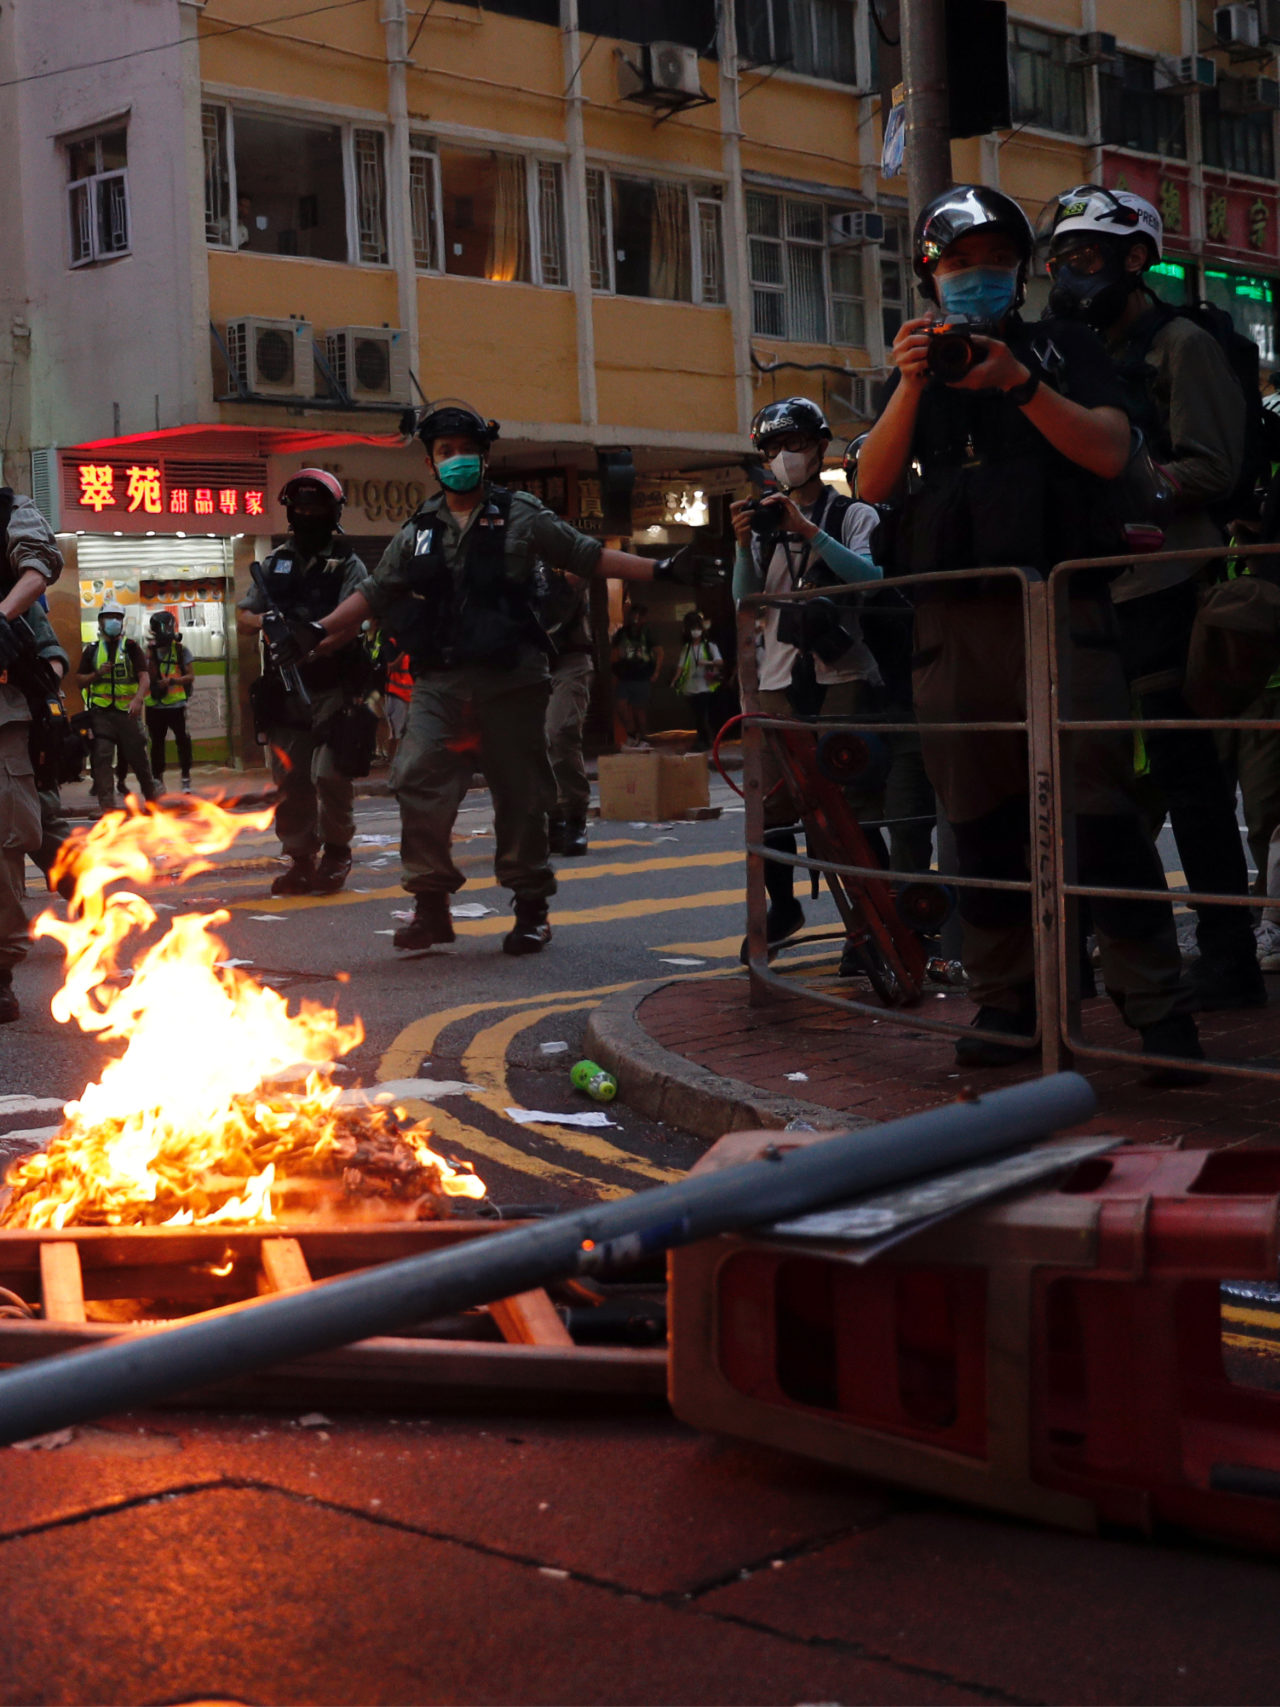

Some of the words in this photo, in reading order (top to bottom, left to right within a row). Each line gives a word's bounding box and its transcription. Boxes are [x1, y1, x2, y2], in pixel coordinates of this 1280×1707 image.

[78, 464, 163, 515] 翠苑
[170, 488, 265, 516] 甜品專家
